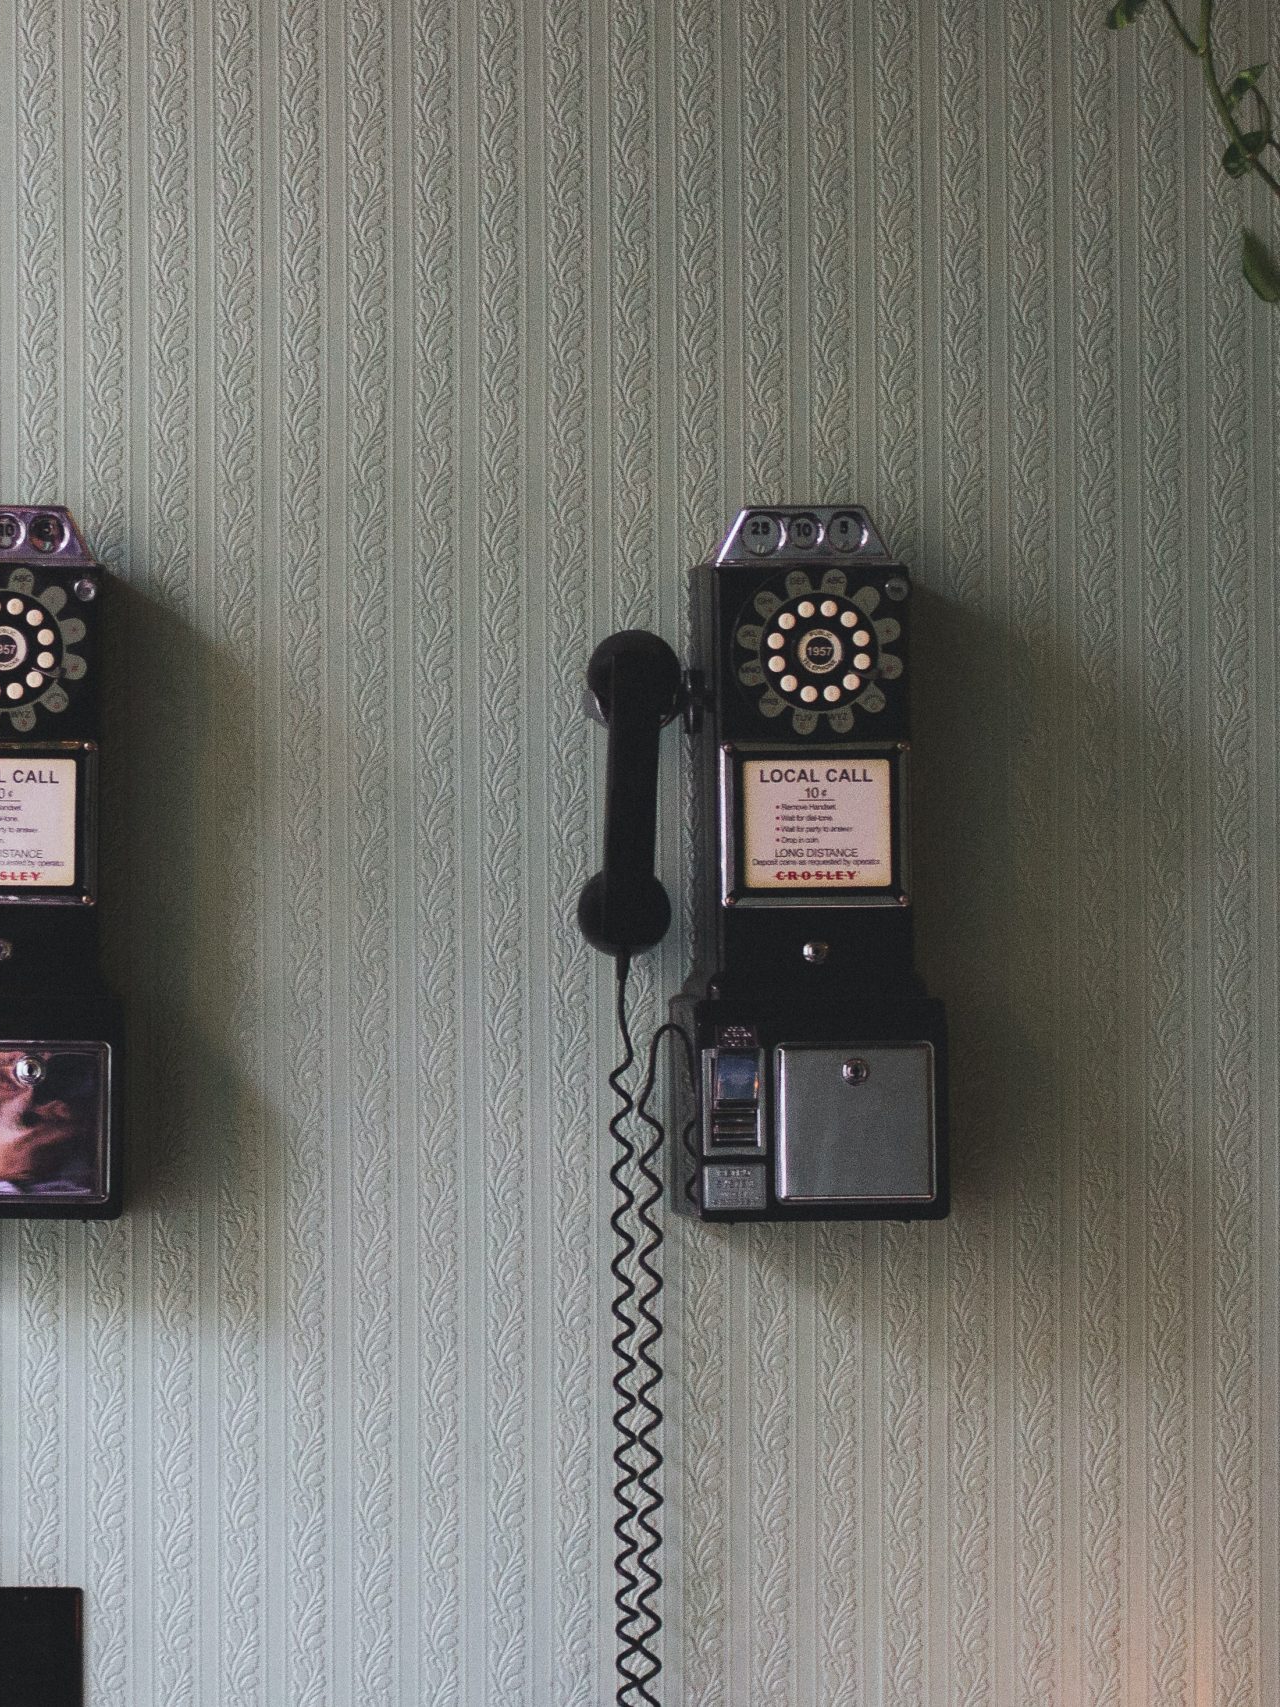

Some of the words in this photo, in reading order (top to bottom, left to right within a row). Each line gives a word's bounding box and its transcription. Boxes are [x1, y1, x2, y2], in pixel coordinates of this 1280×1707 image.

[751, 522, 770, 535] 25
[795, 523, 812, 537] 10
[840, 521, 848, 534] 5
[807, 646, 832, 656] 1957
[13, 770, 60, 784] CALL
[760, 769, 820, 783] LOCAL
[825, 769, 873, 783] CALL
[804, 787, 819, 798] 10
[775, 848, 804, 858] LONG
[806, 848, 858, 858] DISTANCE
[752, 858, 777, 866] Deposit
[808, 858, 841, 866] requested
[843, 859, 851, 867] by
[776, 871, 856, 880] CROSLEY
